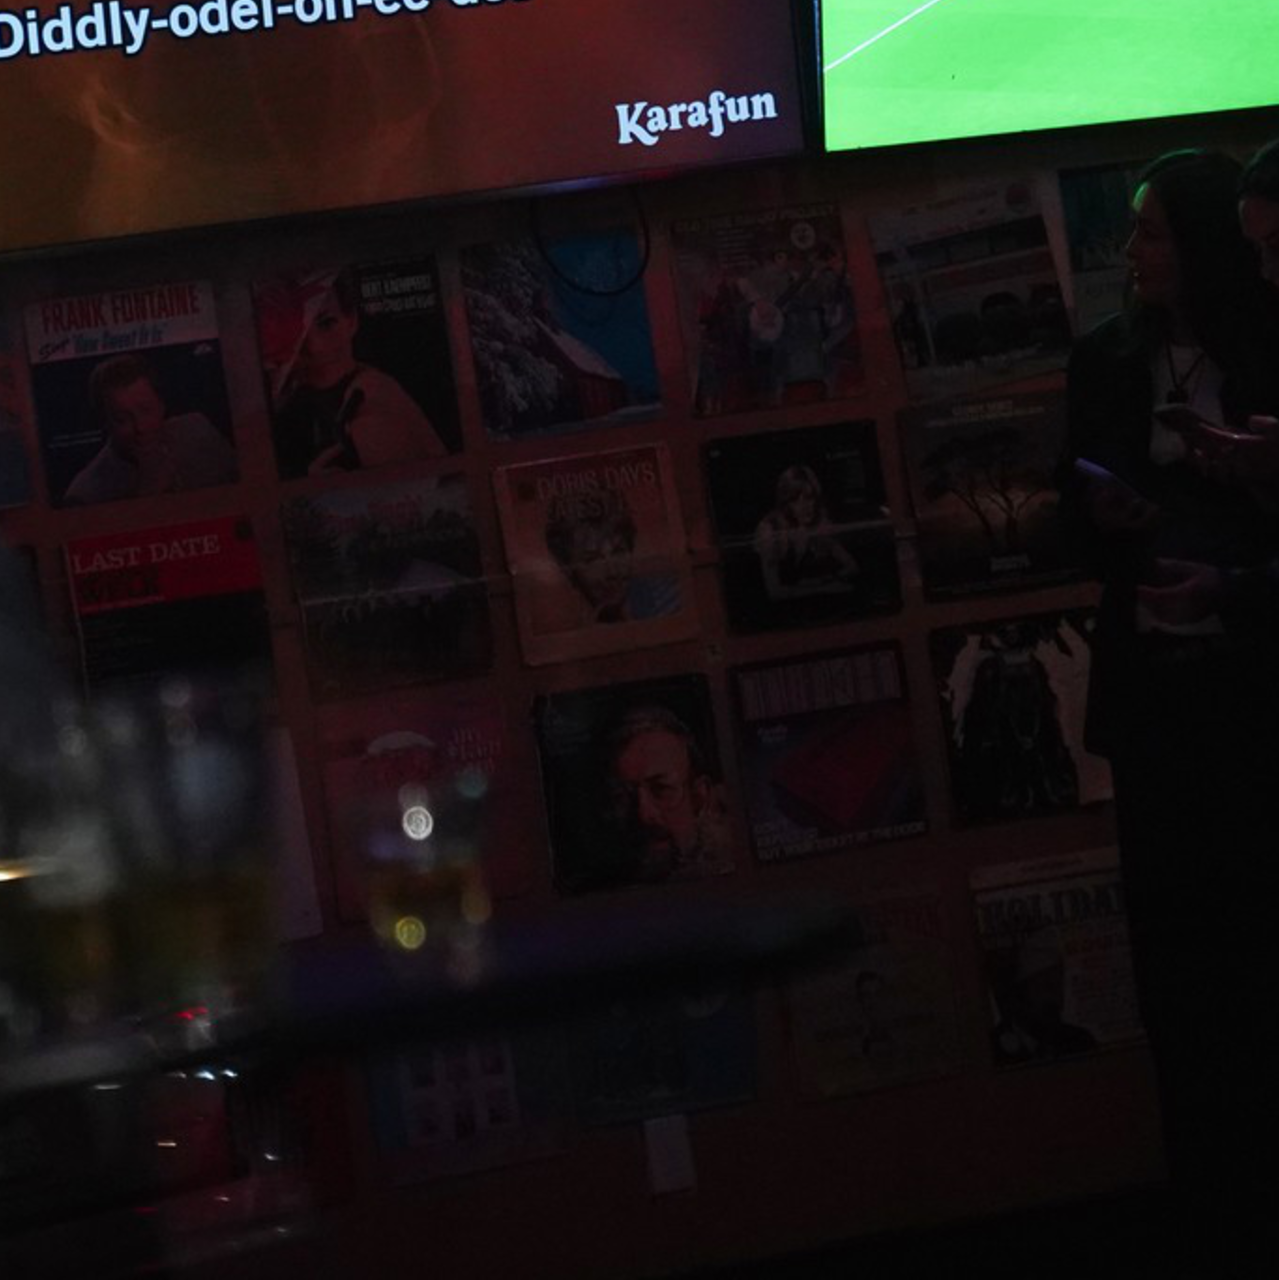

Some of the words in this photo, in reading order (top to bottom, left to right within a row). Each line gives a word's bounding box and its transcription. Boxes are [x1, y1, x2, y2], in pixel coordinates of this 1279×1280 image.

[615, 90, 778, 146] Karafun
[41, 296, 107, 334] FRANK
[110, 284, 201, 324] FONTAINE
[536, 469, 601, 501] DORIS
[72, 546, 142, 575] LAST
[148, 534, 221, 563] DATE
